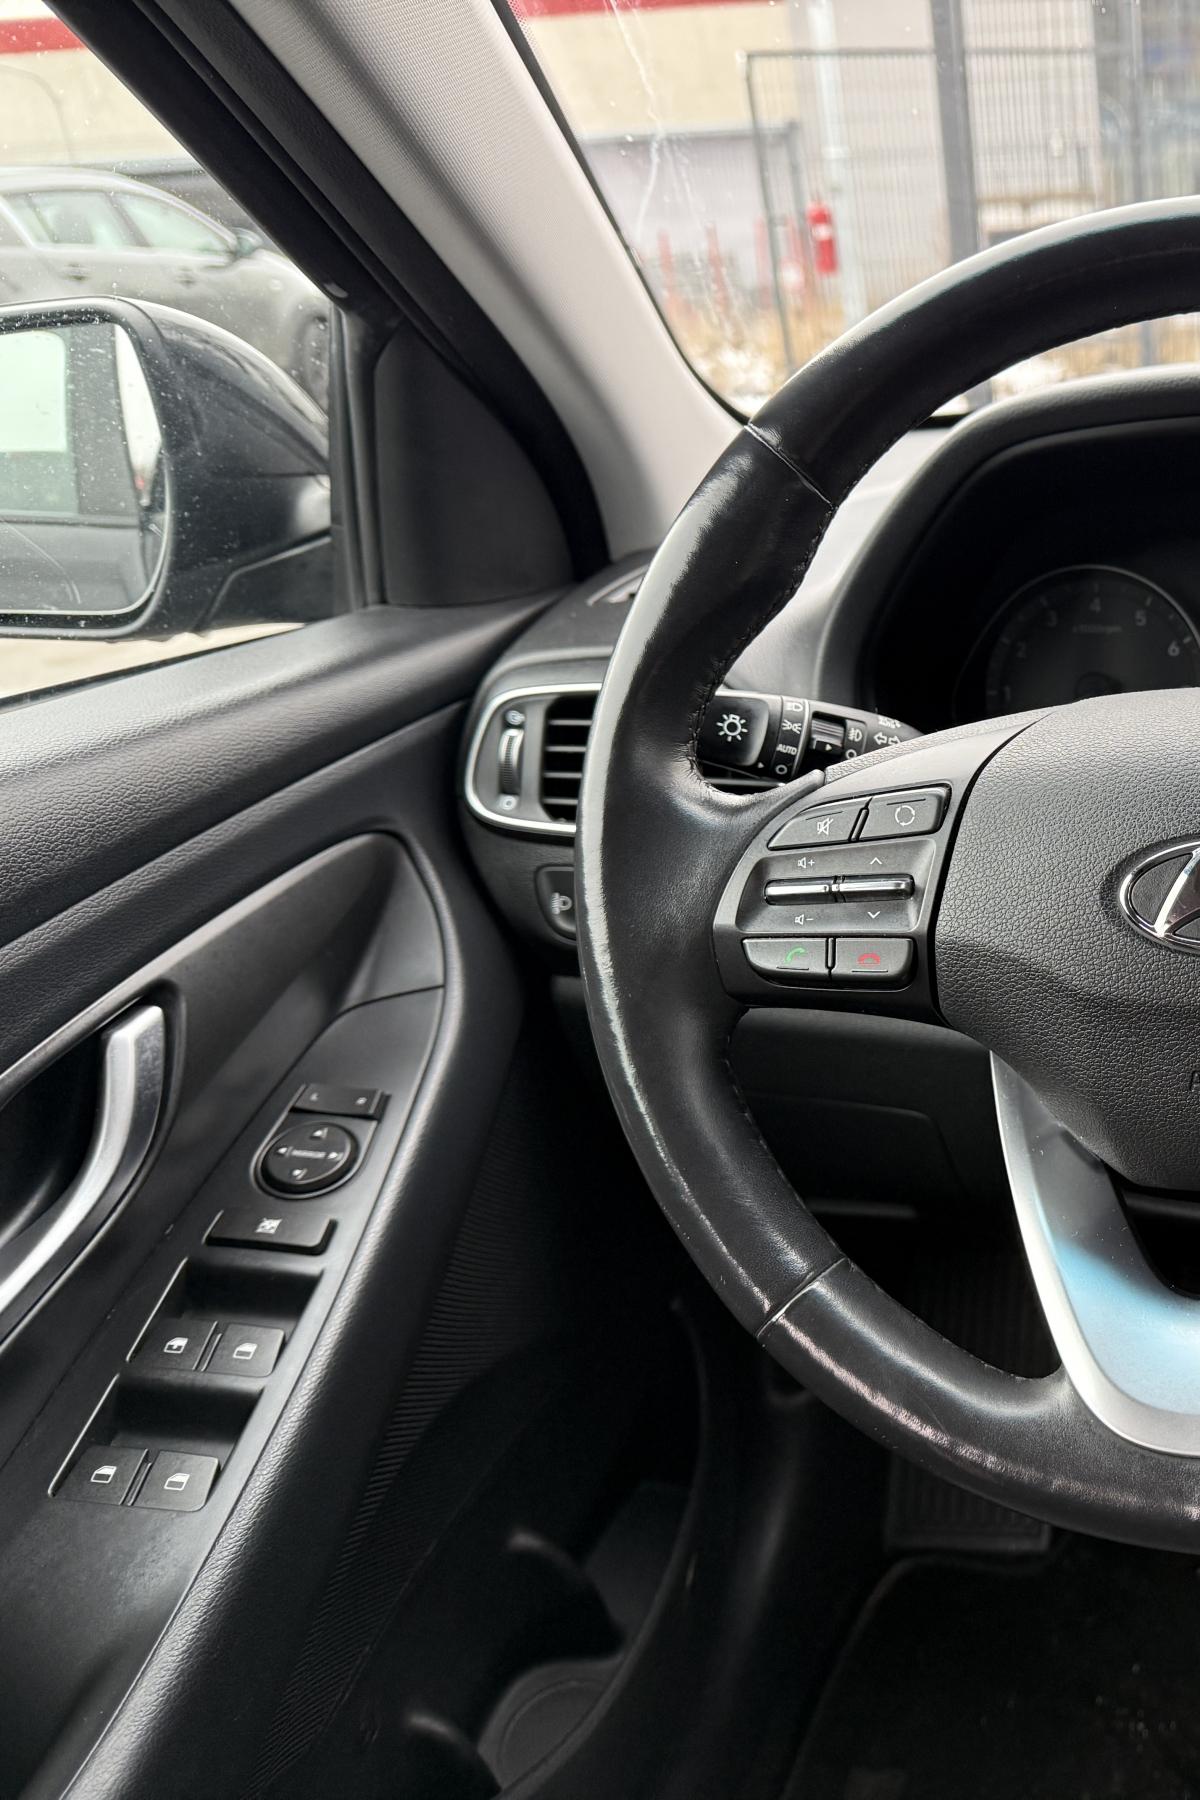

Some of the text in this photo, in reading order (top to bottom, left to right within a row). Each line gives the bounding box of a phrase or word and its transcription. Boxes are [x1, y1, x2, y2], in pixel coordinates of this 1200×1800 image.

[1135, 610, 1146, 627] 5
[1168, 641, 1180, 657] 6
[776, 744, 798, 755] AUTO
